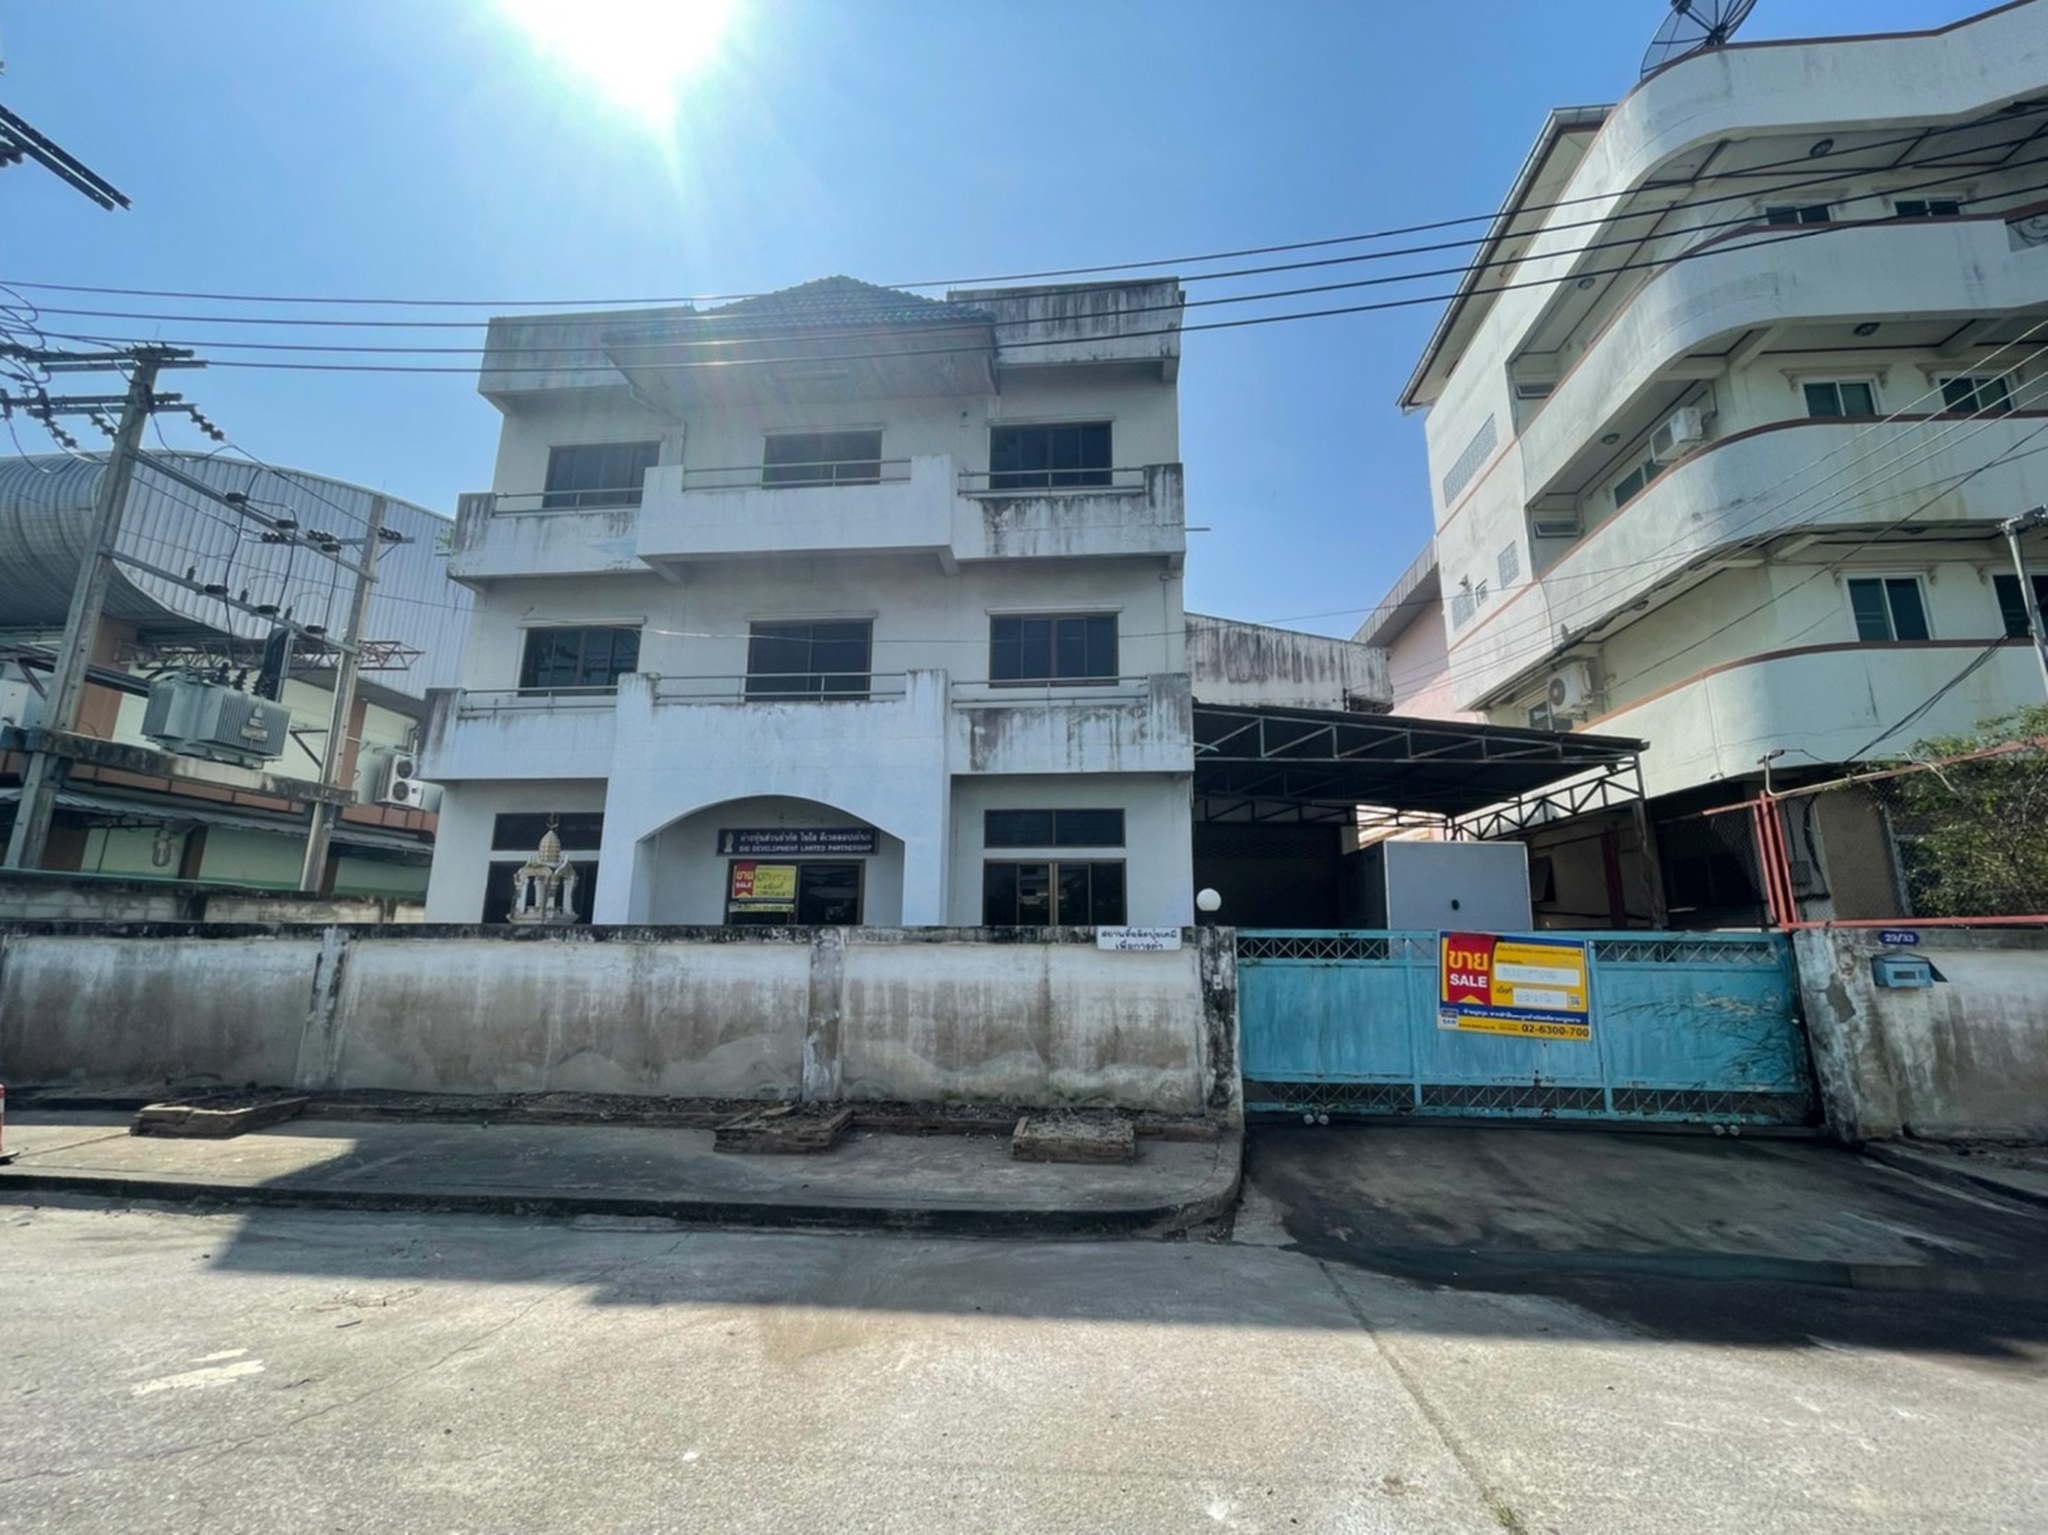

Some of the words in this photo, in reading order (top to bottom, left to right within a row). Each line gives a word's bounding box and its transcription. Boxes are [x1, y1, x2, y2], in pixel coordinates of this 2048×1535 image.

[800, 844, 826, 852] LIMITED
[827, 844, 873, 852] PARTNERSHIP
[736, 881, 752, 889] SALE
[1448, 950, 1489, 971] ขาย
[1449, 973, 1488, 988] SALE
[1521, 1023, 1590, 1038] 02-6300-700
